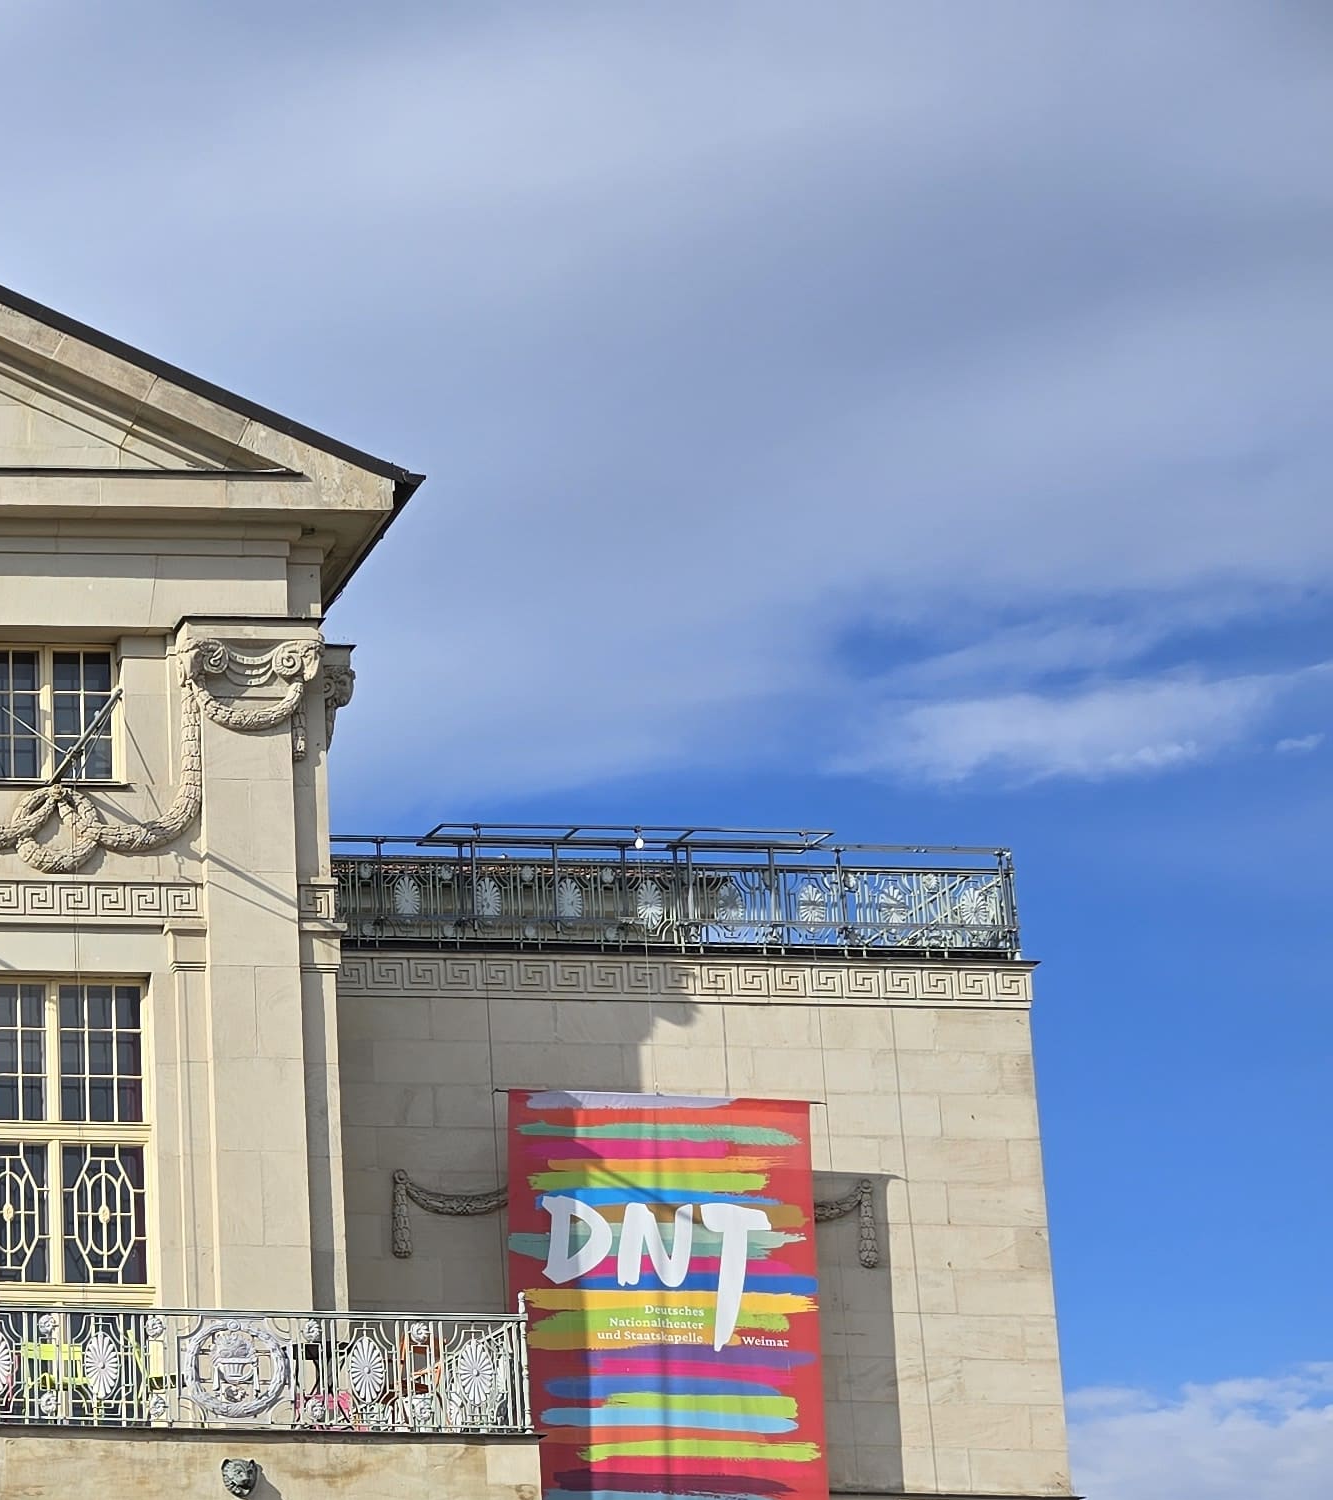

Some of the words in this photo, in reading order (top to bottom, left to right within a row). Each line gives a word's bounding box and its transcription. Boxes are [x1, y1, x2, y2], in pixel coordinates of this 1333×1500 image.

[542, 1196, 772, 1352] DNT
[644, 1305, 705, 1317] Deutsches
[609, 1317, 704, 1330] Nationaltheater
[597, 1331, 621, 1341] und
[624, 1331, 704, 1345] Staatskapelle
[742, 1336, 790, 1348] Weimar
